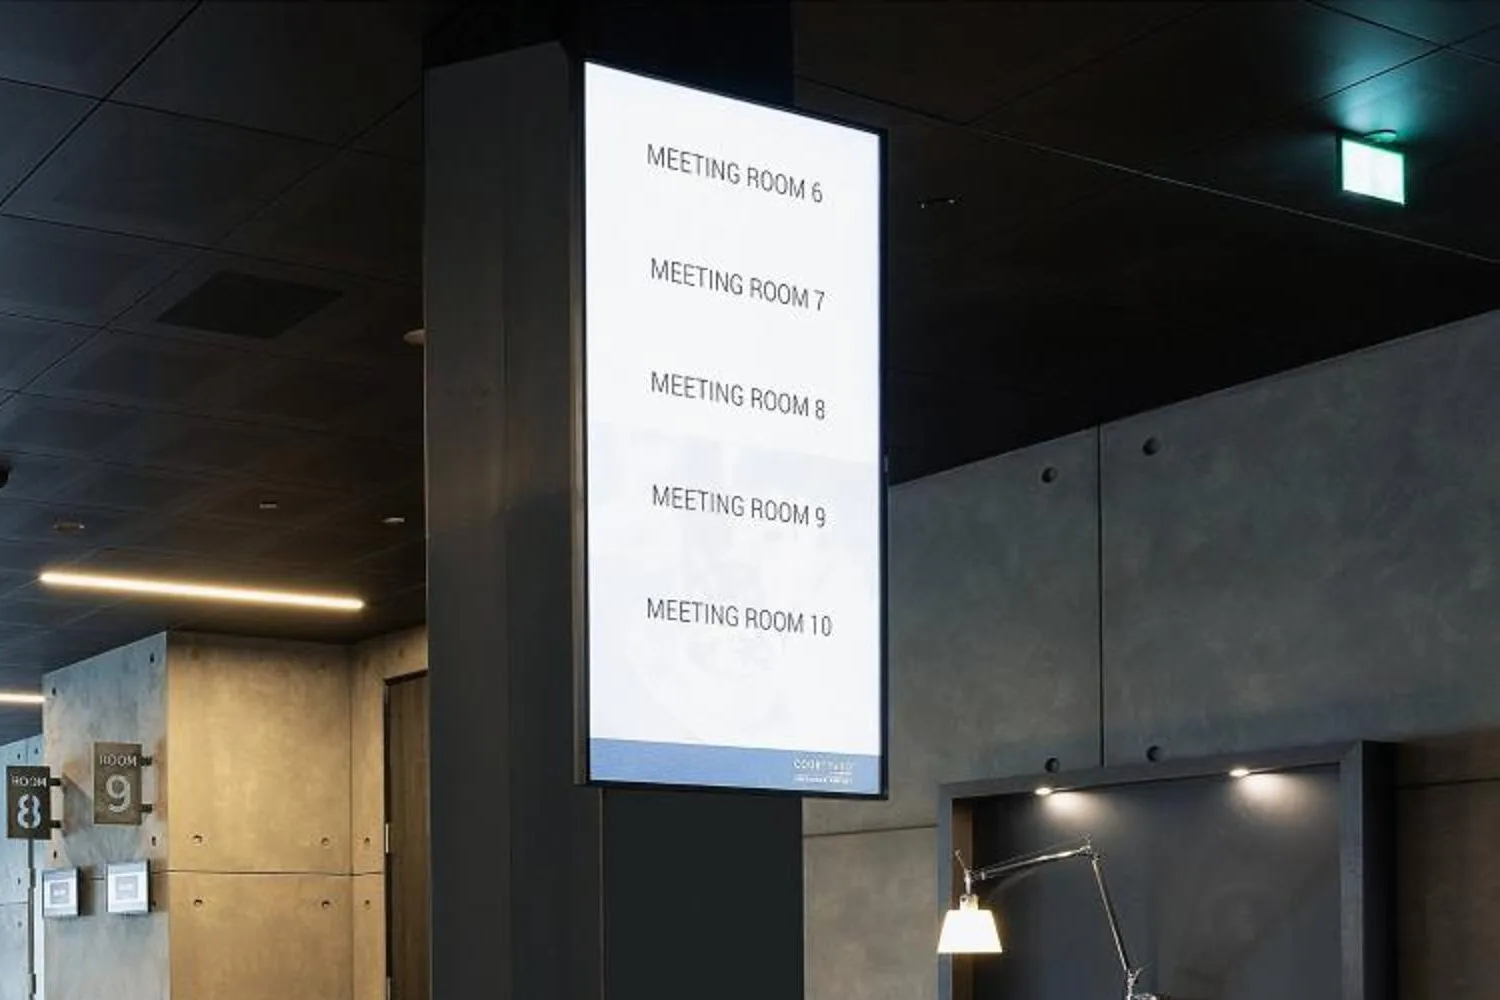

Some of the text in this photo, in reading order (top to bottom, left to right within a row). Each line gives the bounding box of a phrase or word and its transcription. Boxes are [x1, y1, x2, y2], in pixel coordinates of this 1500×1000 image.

[647, 143, 823, 204] MEETING ROOM 6
[650, 257, 826, 312] MEETING ROOM 7
[651, 370, 826, 421] MEETING ROOM 8
[652, 483, 827, 529] MEETING ROOM 9
[647, 597, 833, 637] MEETING ROOM 10
[17, 794, 41, 829] 8
[106, 774, 131, 812] 9
